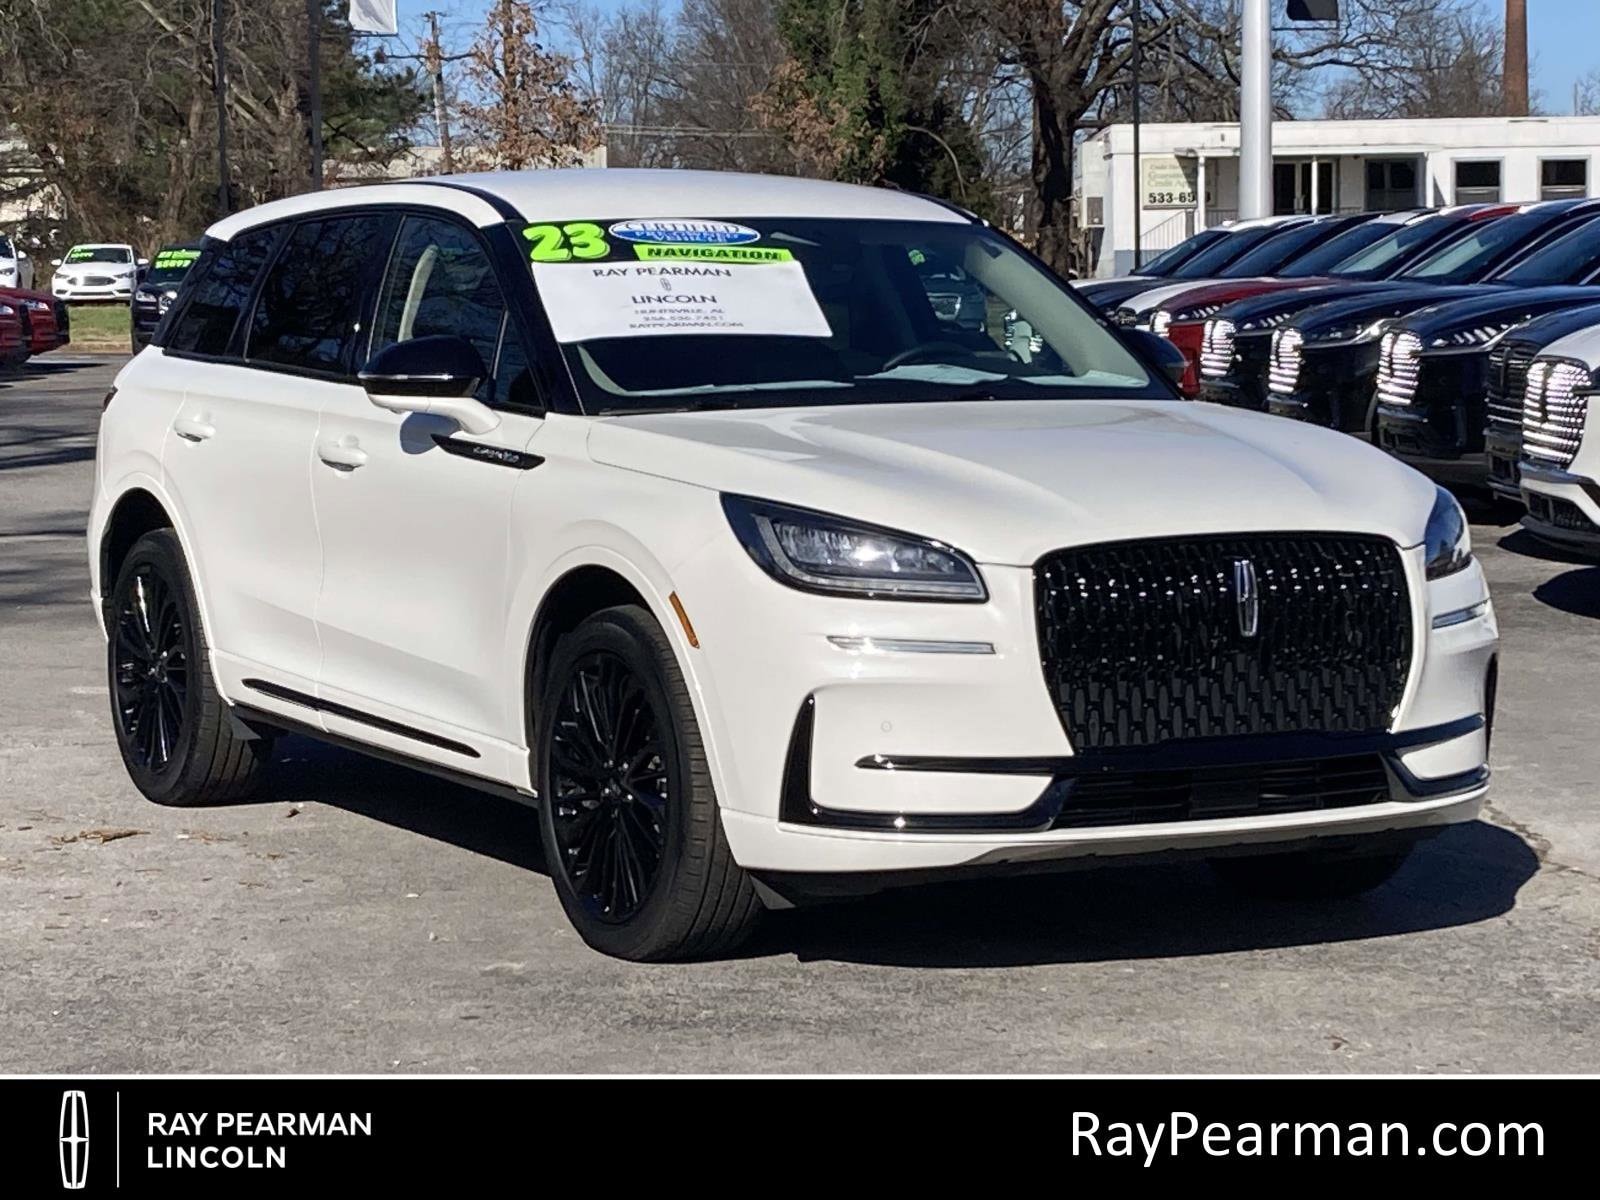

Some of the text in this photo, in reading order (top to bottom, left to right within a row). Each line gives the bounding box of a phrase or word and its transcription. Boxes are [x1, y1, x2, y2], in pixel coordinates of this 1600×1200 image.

[522, 221, 611, 263] 23
[648, 246, 780, 260] NAVIGATION
[593, 266, 733, 277] RAY PEARMAN
[631, 295, 719, 305] LINCOLN
